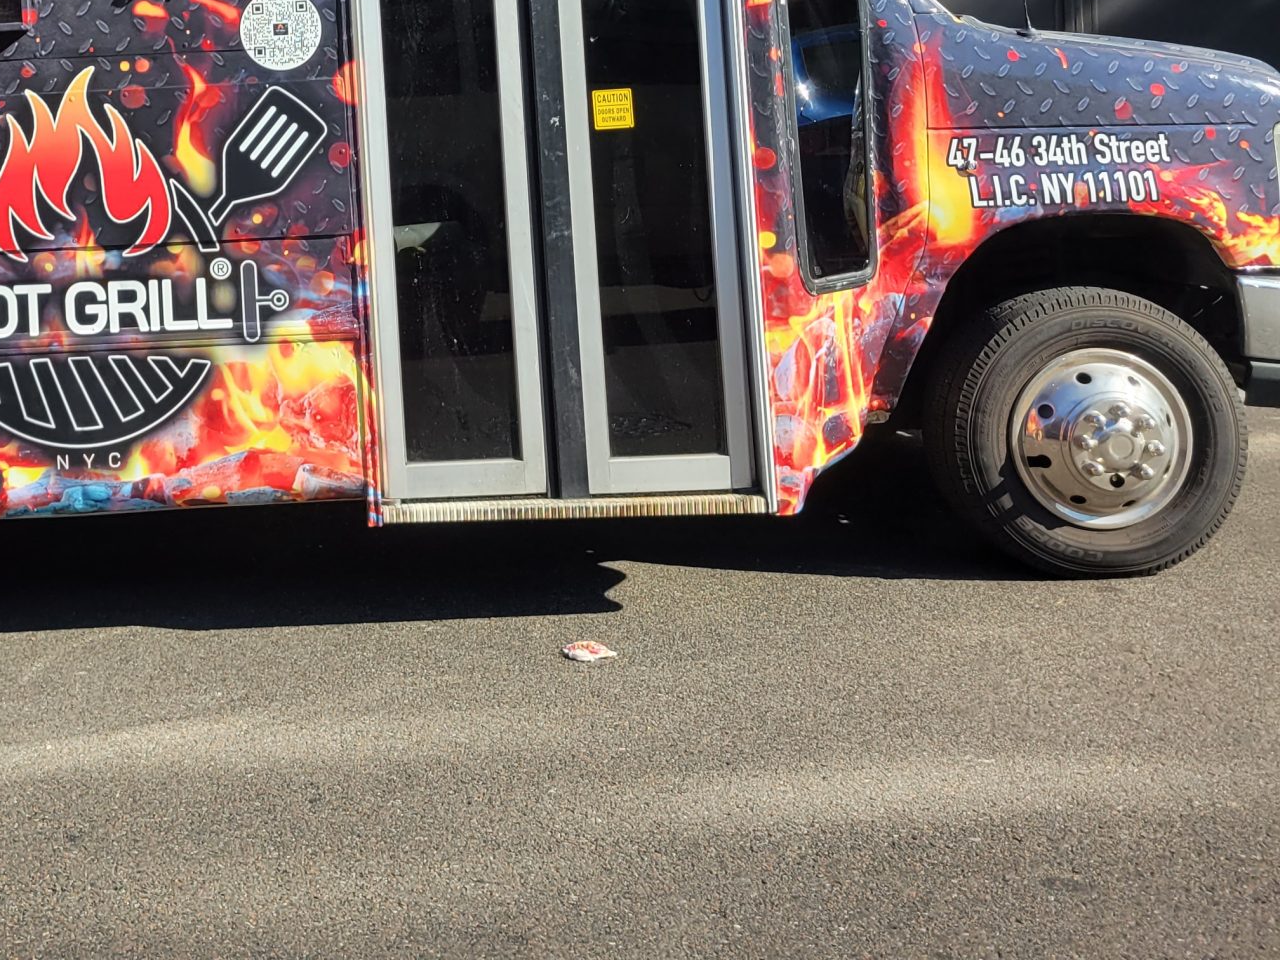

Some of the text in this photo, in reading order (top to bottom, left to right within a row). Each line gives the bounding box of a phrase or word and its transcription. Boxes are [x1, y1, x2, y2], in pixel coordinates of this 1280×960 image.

[597, 93, 628, 103] CAUTION
[948, 133, 1170, 166] 47-46 34th Street
[970, 170, 1159, 207] L.I.C. NY 11101
[1016, 517, 1104, 562] COOPE
